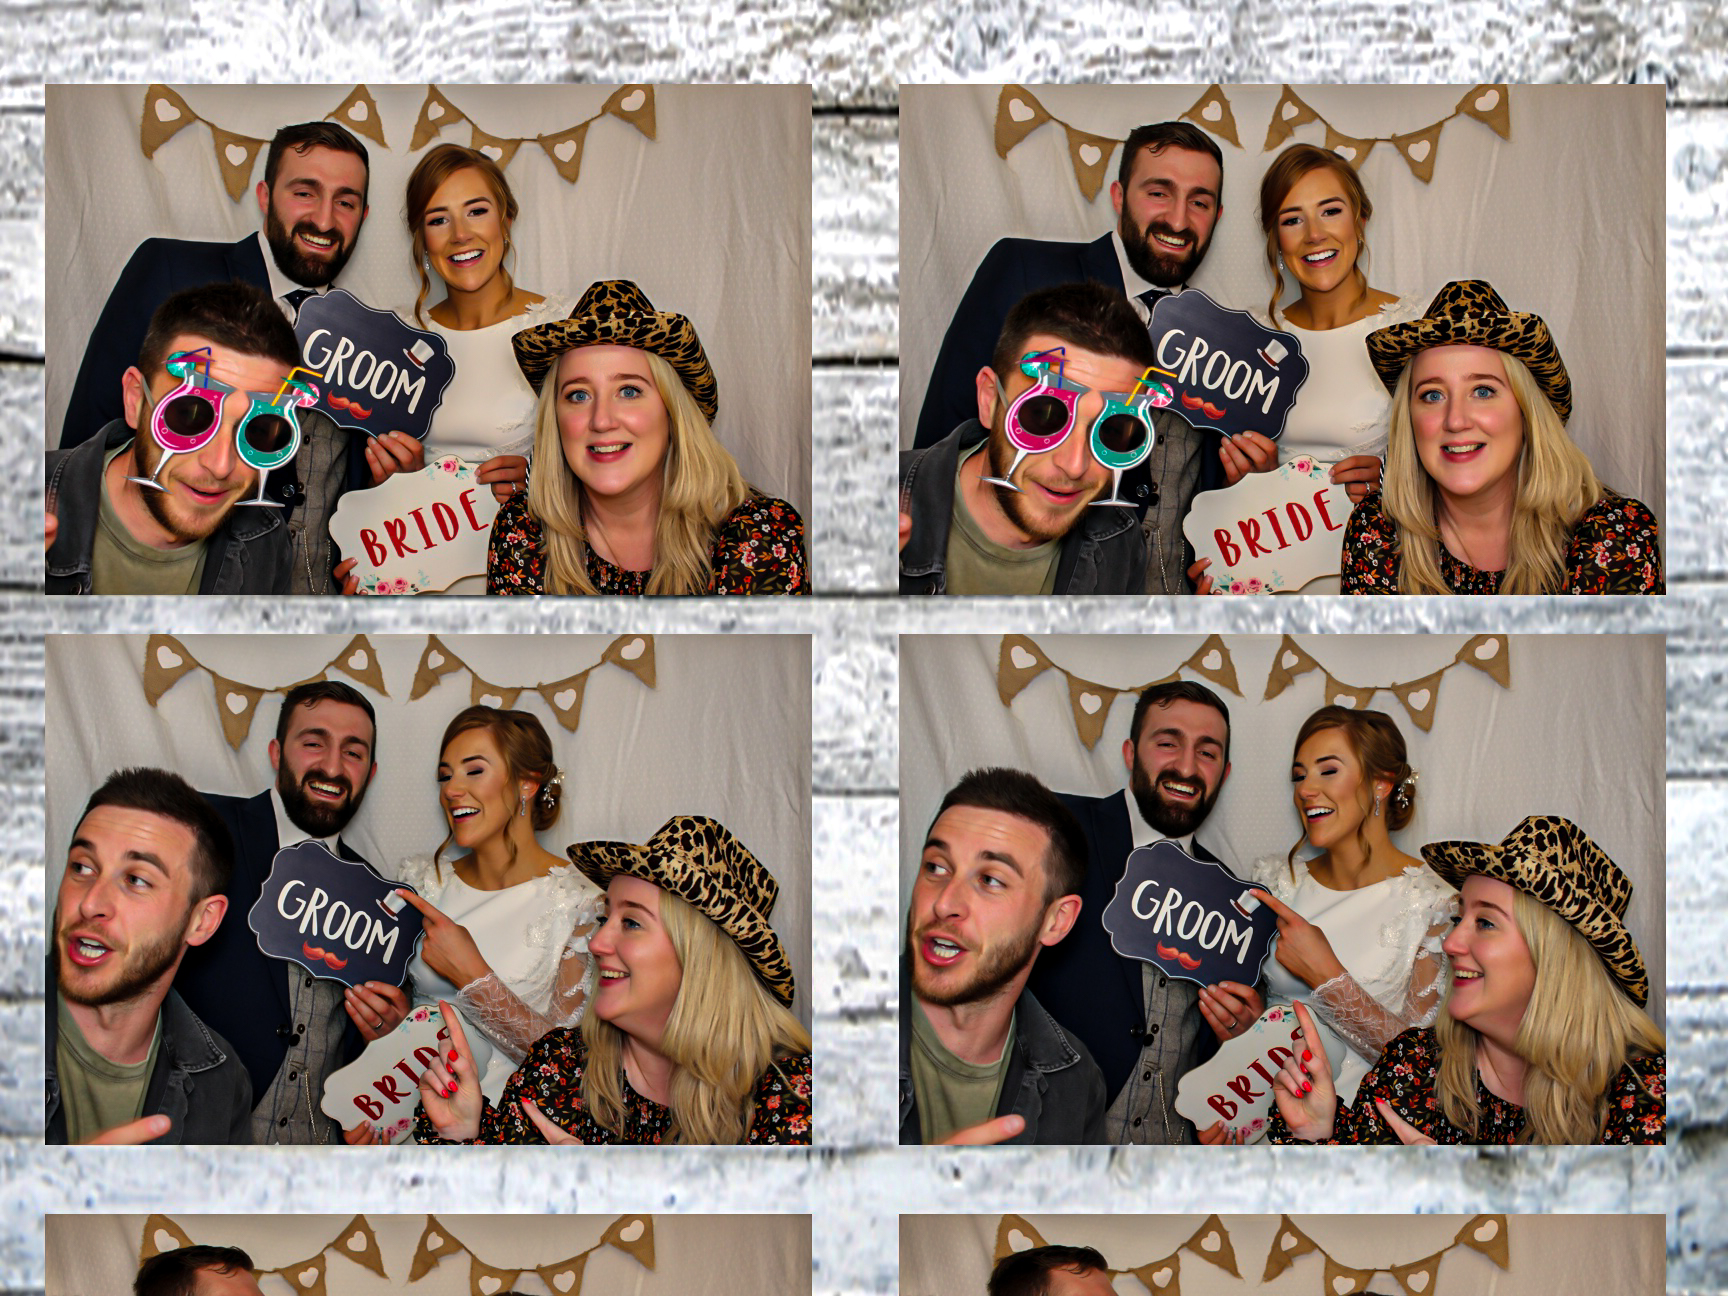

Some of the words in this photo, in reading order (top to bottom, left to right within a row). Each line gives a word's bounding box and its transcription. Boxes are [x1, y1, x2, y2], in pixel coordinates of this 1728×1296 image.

[303, 329, 426, 414] GROOM
[1157, 329, 1280, 414] GROOM
[360, 488, 489, 566] BRIDE
[1214, 488, 1343, 566] BRIDE
[277, 880, 399, 964] GROOM
[1131, 880, 1253, 964] GROOM
[353, 1026, 449, 1121] BRID
[1207, 1026, 1303, 1121] BRID
